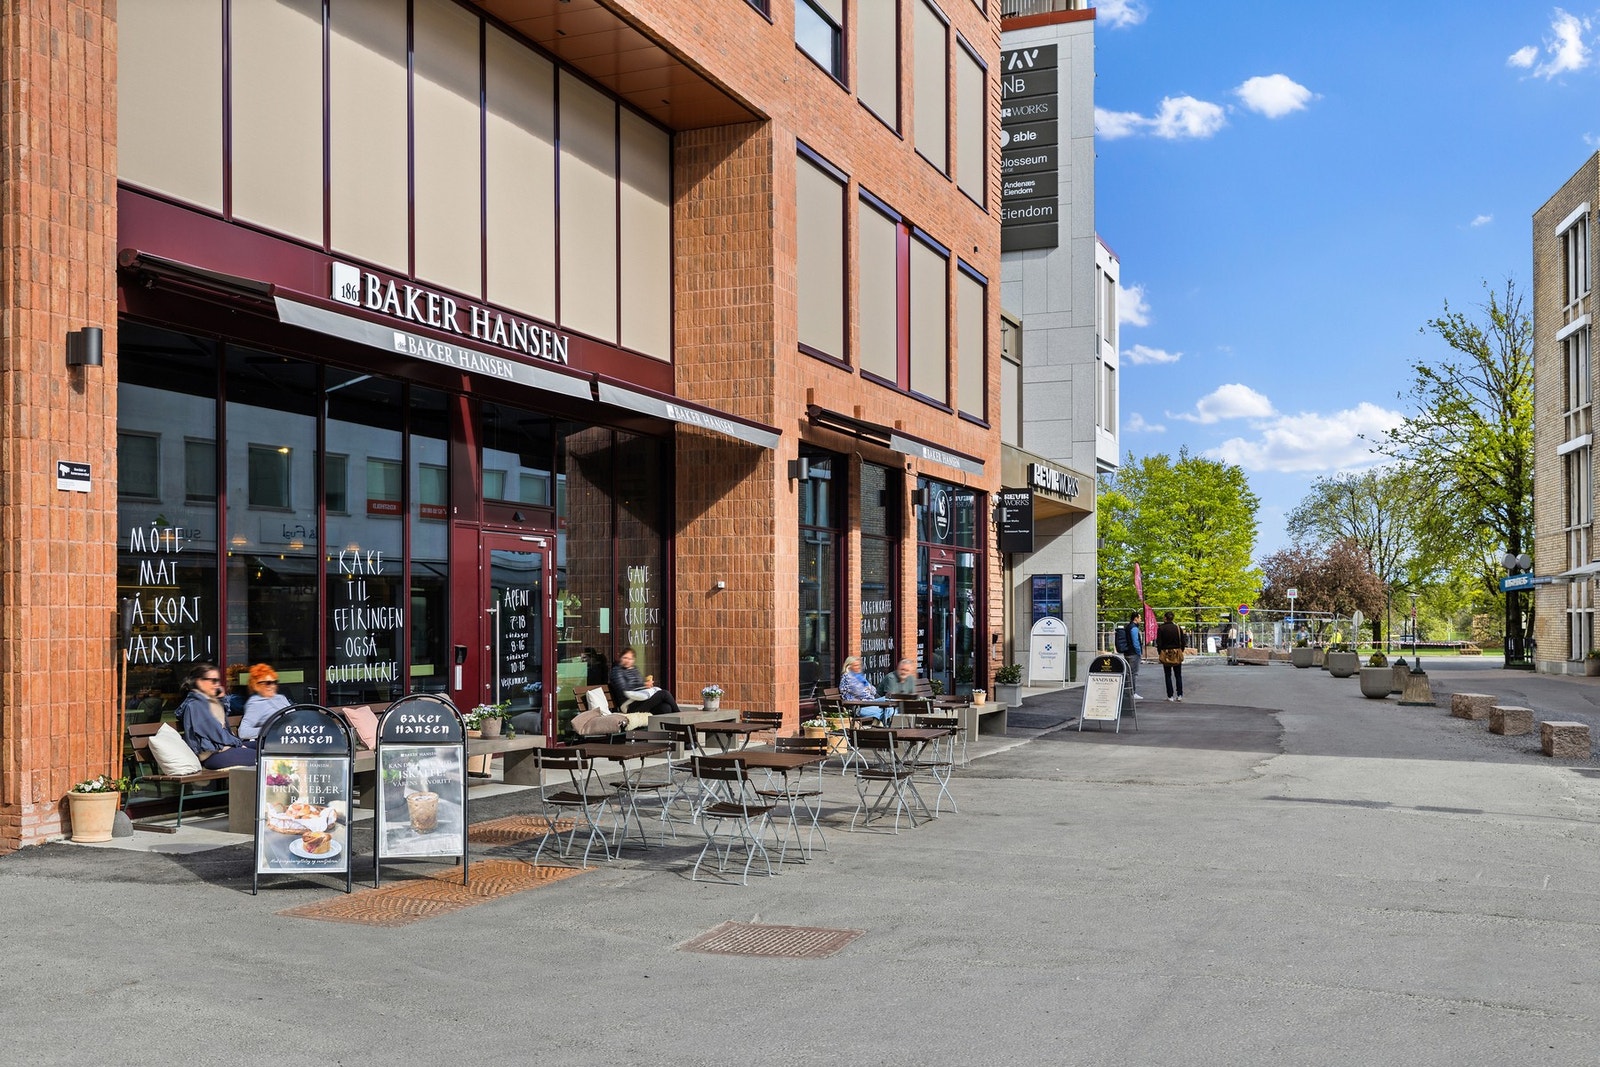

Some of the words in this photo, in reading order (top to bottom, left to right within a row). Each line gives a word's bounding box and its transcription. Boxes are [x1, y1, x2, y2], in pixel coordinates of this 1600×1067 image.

[1001, 75, 1026, 98] NB
[1013, 131, 1036, 142] able
[1001, 155, 1047, 168] olosseum
[1004, 180, 1035, 189] Andenæs
[1004, 188, 1033, 196] Eiendom
[1001, 205, 1053, 219] Eiendom
[363, 272, 463, 335] BAKER
[470, 305, 569, 366] HANSEN
[408, 336, 456, 365] BAKER
[458, 349, 514, 378] HANSEN
[674, 407, 702, 427] BAKER
[702, 414, 735, 435] HANSEN
[139, 559, 178, 586] MAT
[339, 550, 384, 575] KAKE
[347, 577, 371, 601] TIL
[505, 587, 529, 611] ÅPENT
[155, 595, 201, 625] KORT
[334, 604, 403, 631] FEIRINGEN
[624, 607, 660, 625] PERFEKT
[862, 600, 892, 615] ORGENKAFFE
